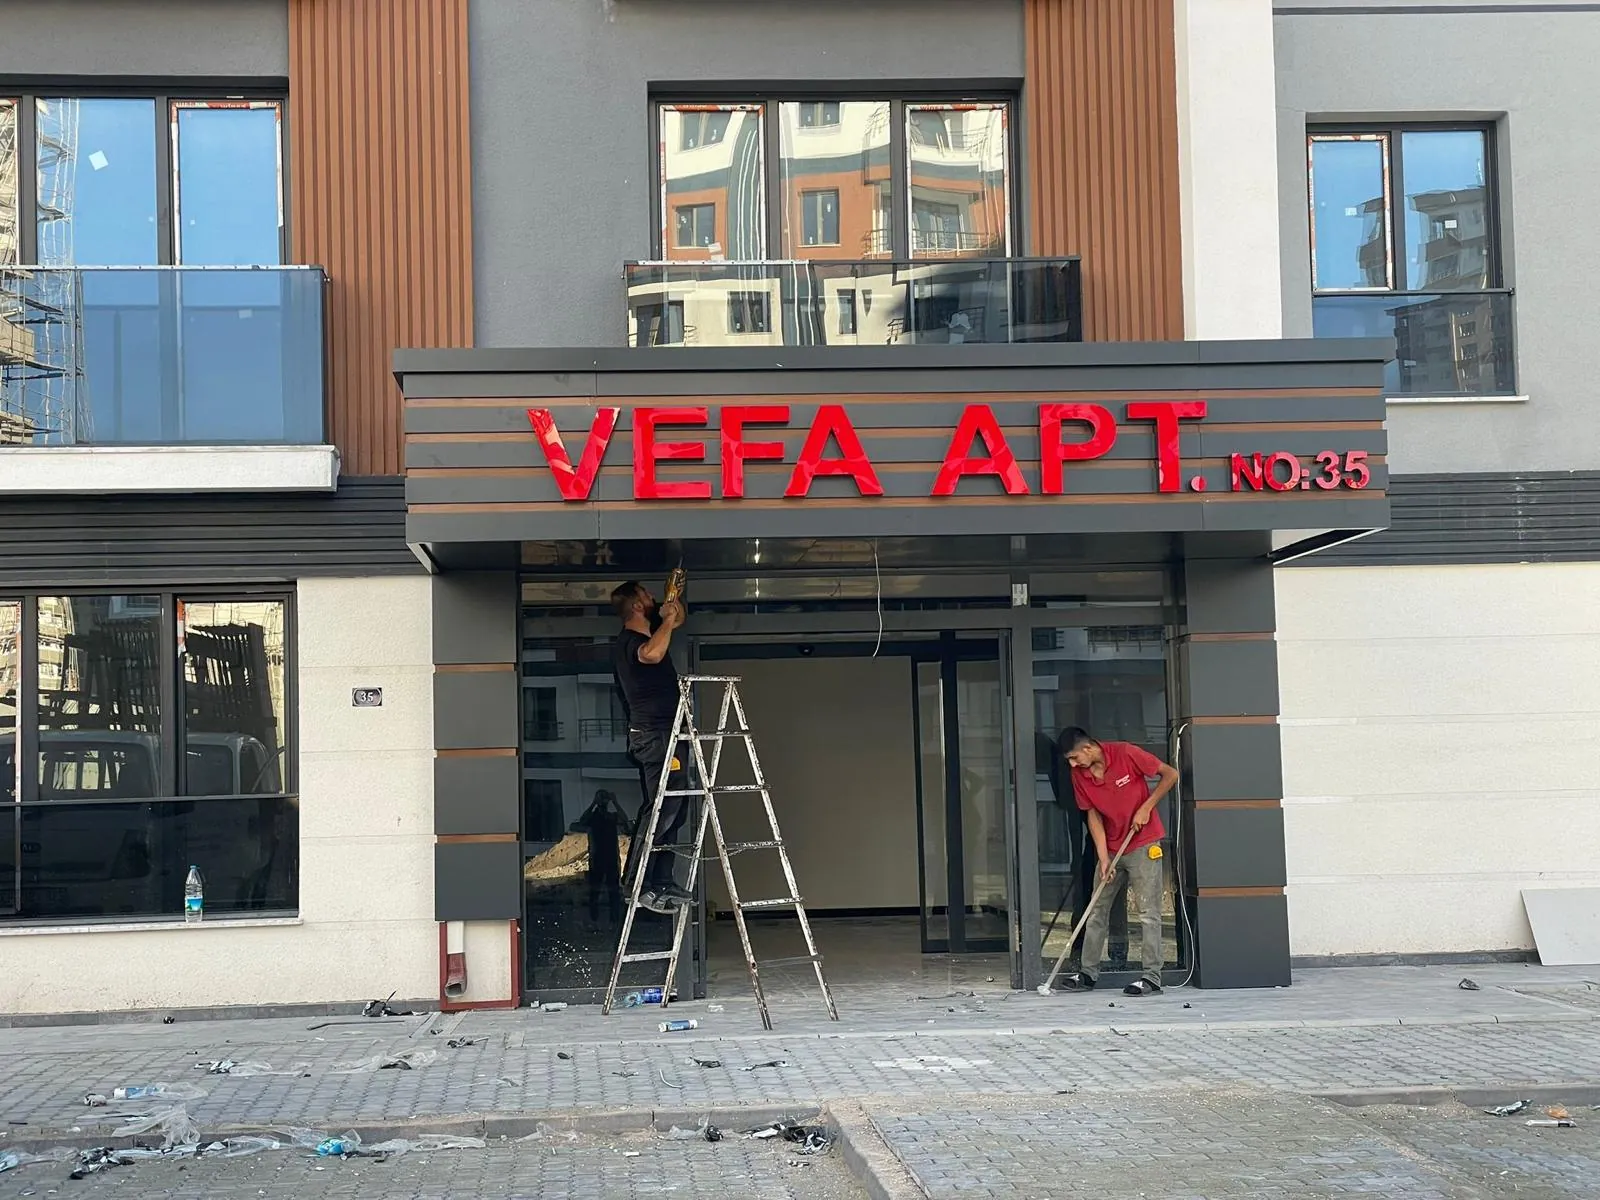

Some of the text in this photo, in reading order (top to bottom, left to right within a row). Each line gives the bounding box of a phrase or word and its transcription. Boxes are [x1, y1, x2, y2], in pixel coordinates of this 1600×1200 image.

[527, 403, 884, 501] VEFA
[930, 400, 1209, 497] APT.
[360, 691, 374, 702] 35
